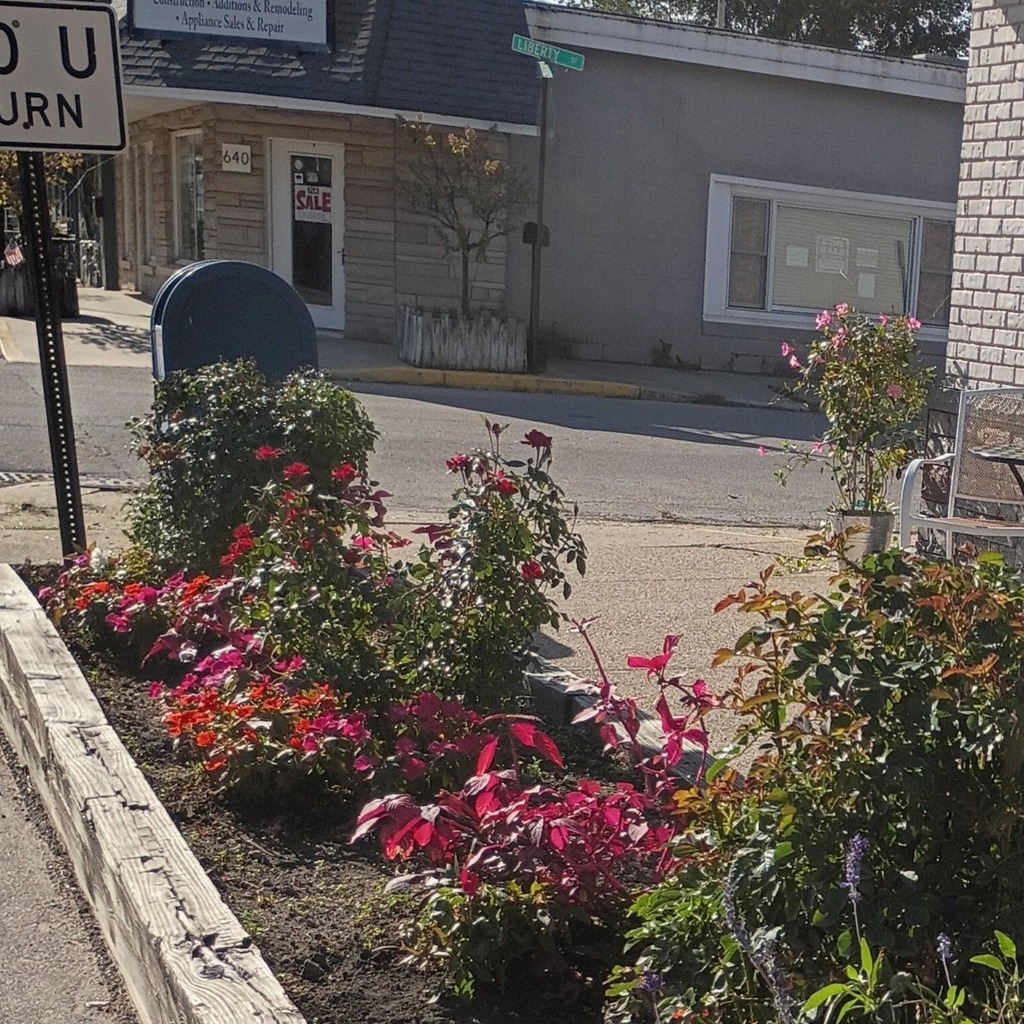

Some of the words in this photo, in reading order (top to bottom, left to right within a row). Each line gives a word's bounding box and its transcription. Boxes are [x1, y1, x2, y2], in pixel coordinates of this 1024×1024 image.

[252, 2, 262, 13] &
[263, 1, 313, 21] Remodeling
[181, 11, 222, 31] Appliance
[223, 14, 245, 29] Sales
[246, 17, 255, 31] &
[257, 21, 284, 36] Repair
[58, 26, 97, 79] U
[517, 38, 561, 60] LIBERTY
[223, 150, 249, 166] 640
[296, 190, 331, 213] SALE
